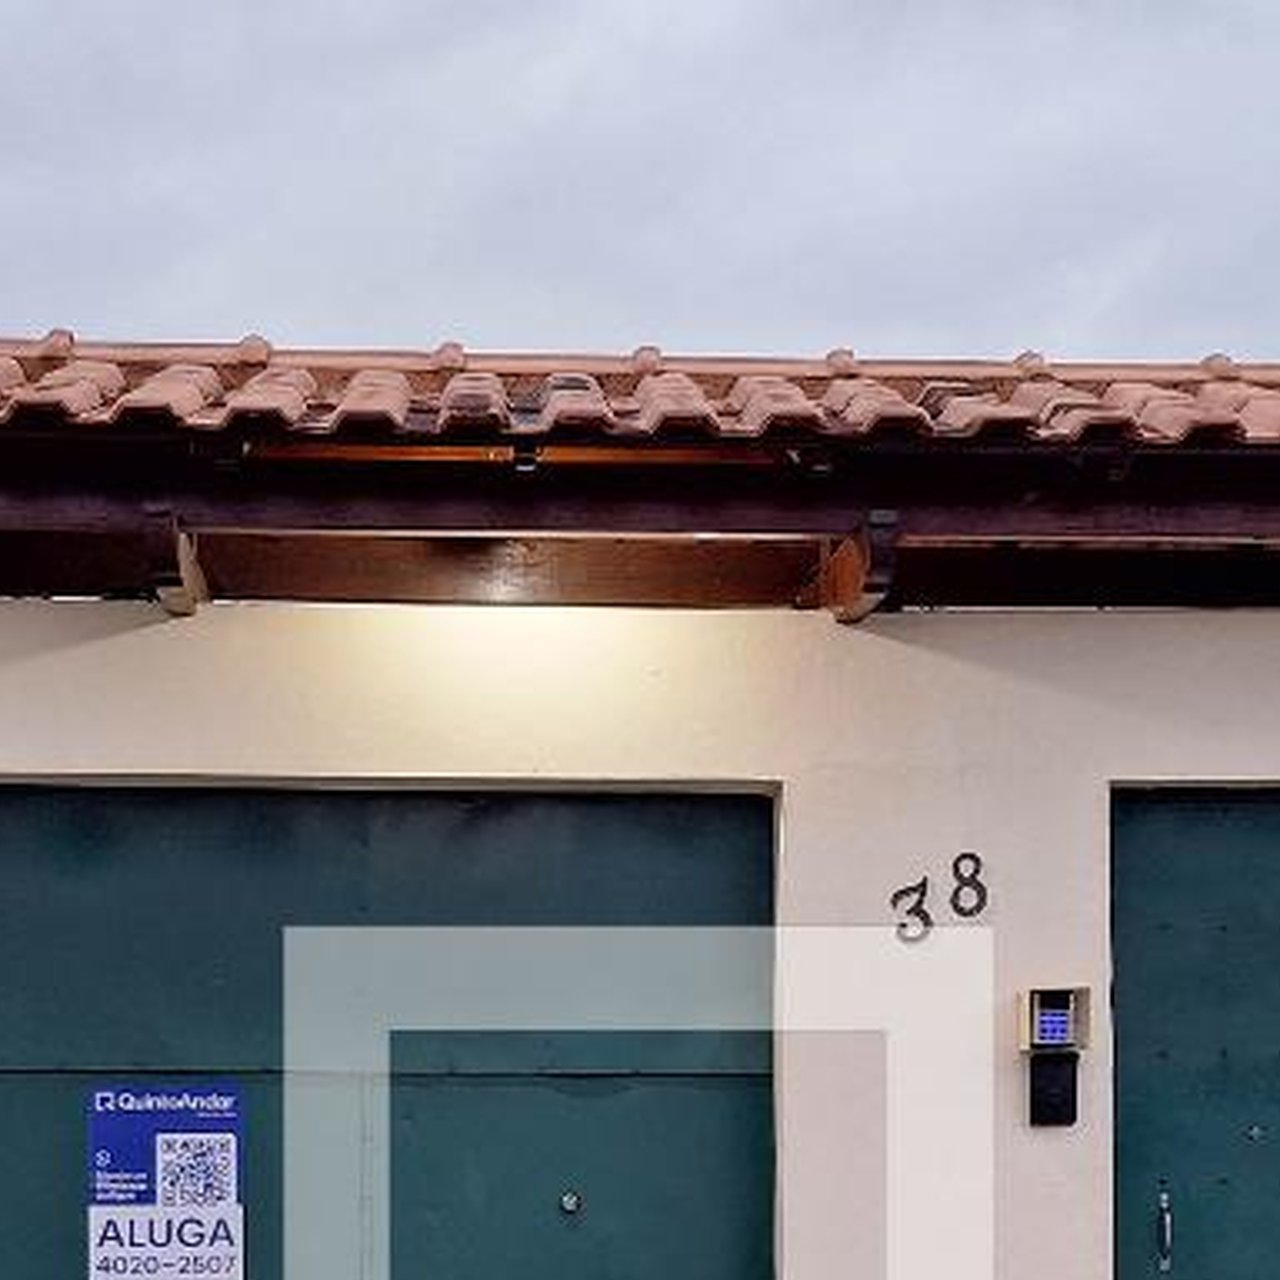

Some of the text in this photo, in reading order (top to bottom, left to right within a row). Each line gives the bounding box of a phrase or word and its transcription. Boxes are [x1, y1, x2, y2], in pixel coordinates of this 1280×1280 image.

[891, 852, 987, 942] 38
[119, 1091, 237, 1111] QuintoAndar
[97, 1219, 234, 1247] ALUGA
[96, 1256, 235, 1274] 4020-2507
